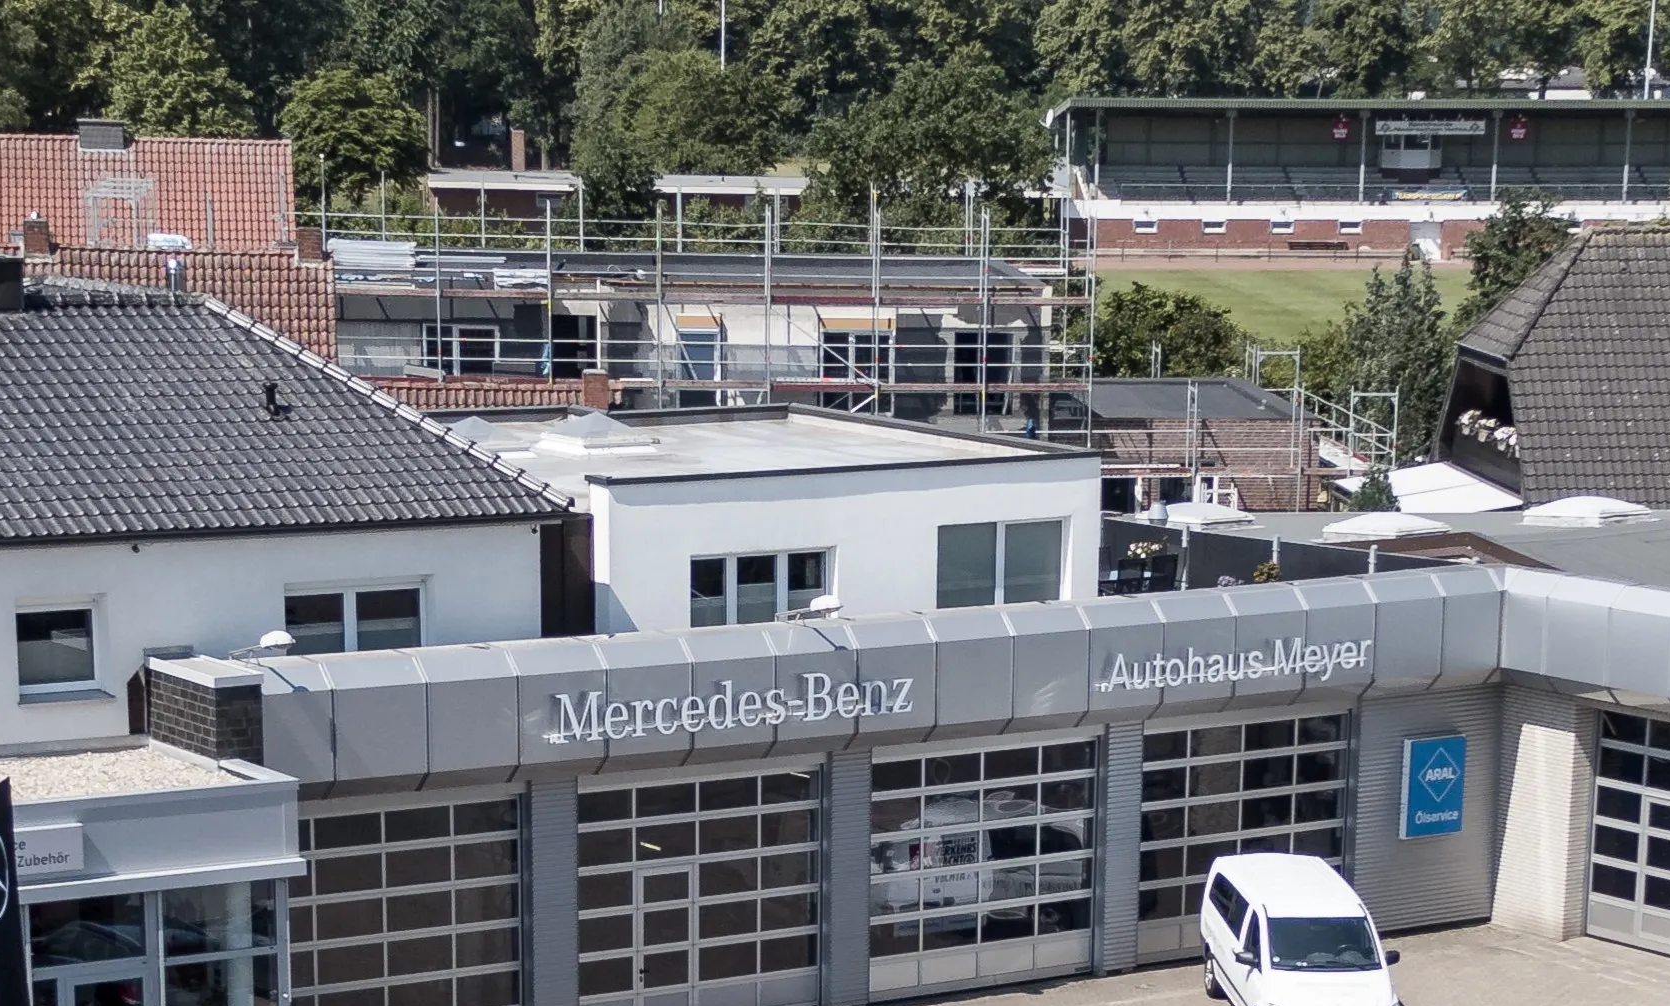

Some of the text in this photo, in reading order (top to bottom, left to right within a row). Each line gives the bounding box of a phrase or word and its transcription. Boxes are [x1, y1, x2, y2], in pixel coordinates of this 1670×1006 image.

[1107, 637, 1372, 693] Autohaus Meyer
[554, 671, 915, 745] Mercedes-Benz
[1424, 767, 1456, 782] ARAL
[1414, 809, 1460, 825] Ölservice
[16, 851, 70, 868] Zubehör
